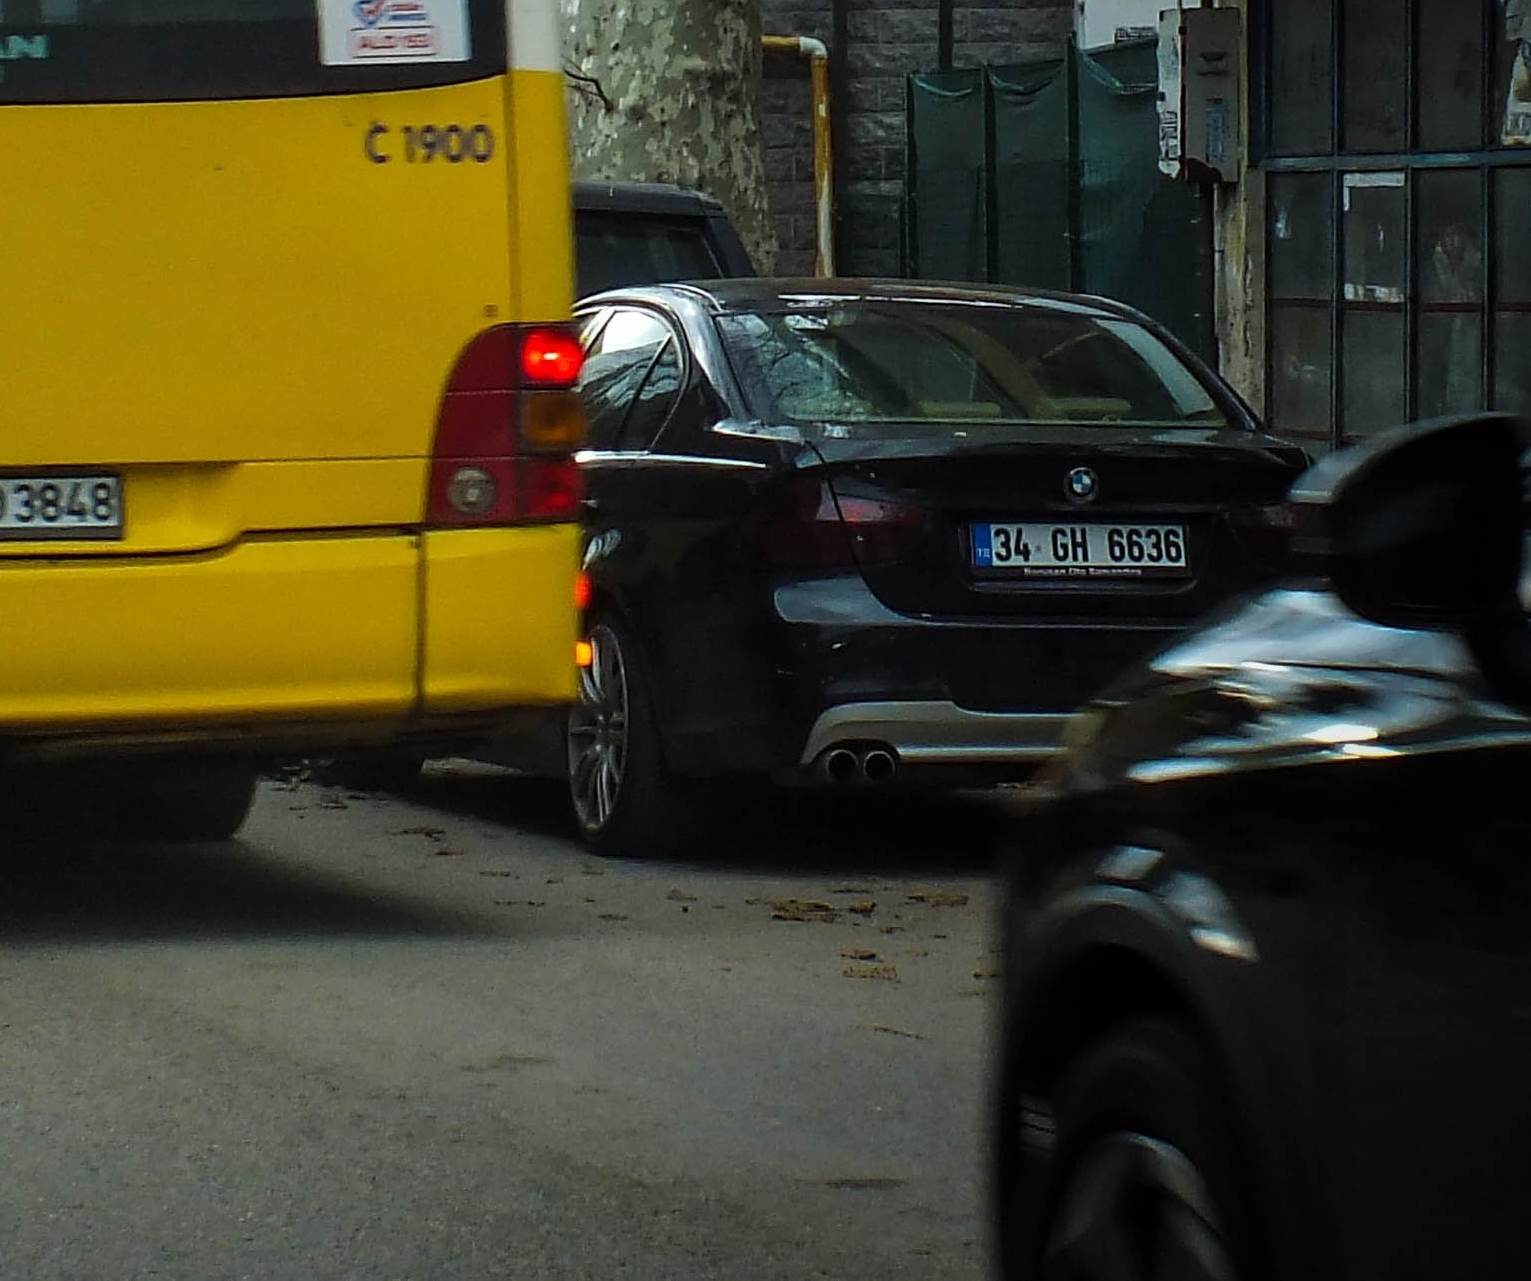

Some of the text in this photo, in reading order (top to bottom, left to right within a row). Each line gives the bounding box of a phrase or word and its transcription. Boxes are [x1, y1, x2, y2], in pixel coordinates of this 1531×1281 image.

[403, 123, 495, 163] 1900
[993, 527, 1182, 563] 34 GH 6636
